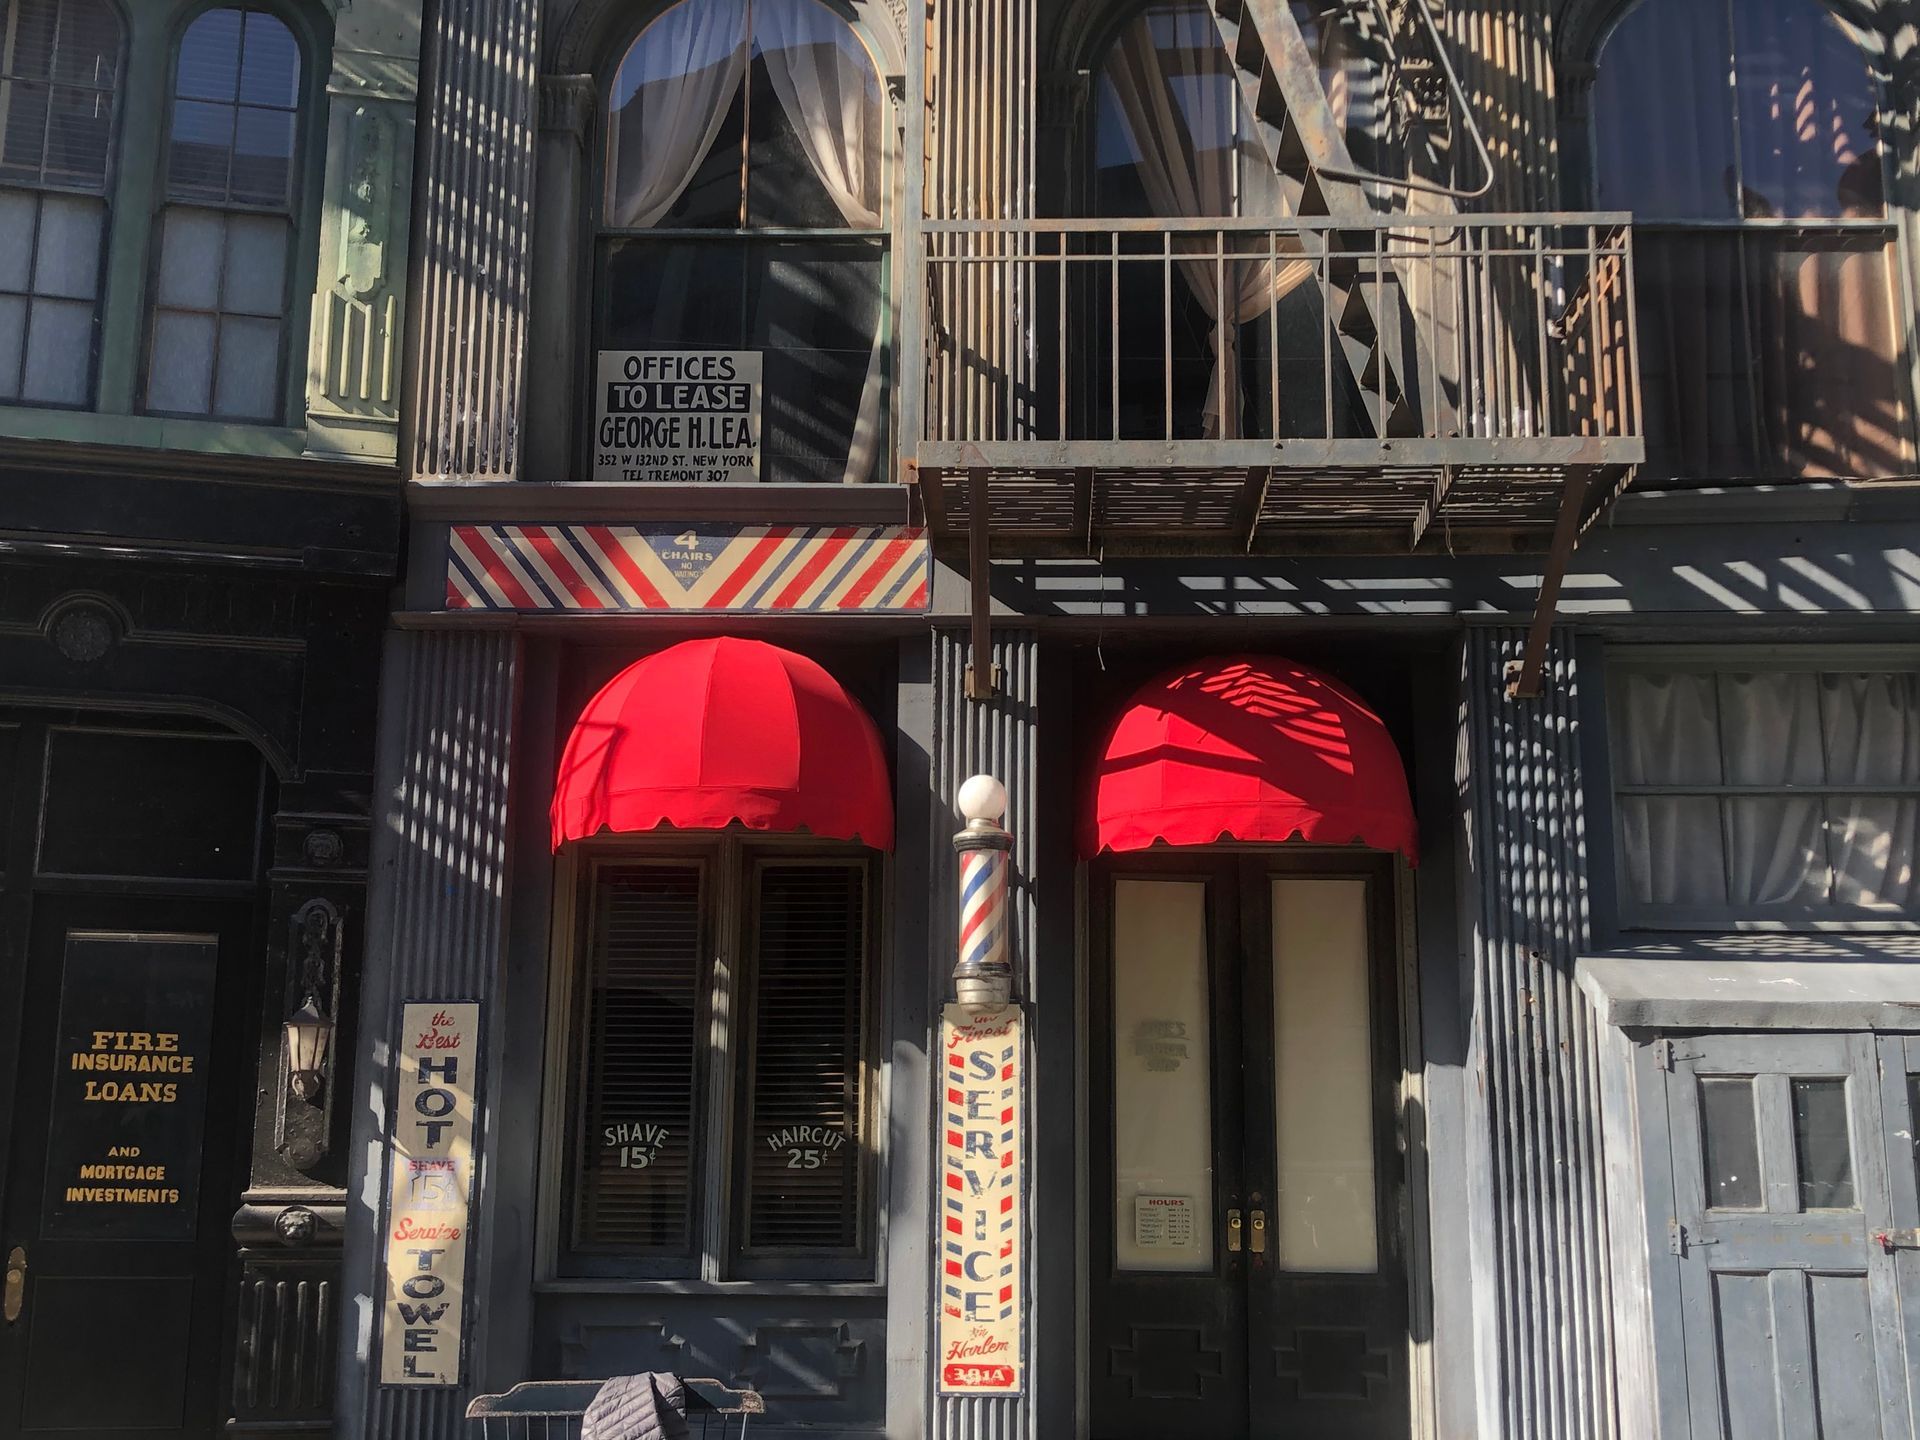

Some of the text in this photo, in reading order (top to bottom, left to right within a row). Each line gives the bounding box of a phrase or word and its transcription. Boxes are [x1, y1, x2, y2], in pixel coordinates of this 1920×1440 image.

[623, 355, 736, 381] OFFICES
[613, 384, 746, 410] TO LEASE
[600, 416, 681, 449] GEORGE
[598, 454, 754, 467] 352 W 132ND ST. NEW YORK
[622, 469, 729, 482] TEL TREMONT 307
[673, 529, 699, 550] 4
[661, 551, 713, 561] CHAIRS
[681, 561, 693, 570] NO
[431, 1010, 456, 1027] the
[91, 1031, 179, 1052] FIRE
[415, 1027, 461, 1050] Best
[71, 1053, 194, 1074] INSURANCE
[84, 1081, 178, 1103] LOANS
[414, 1056, 458, 1149] HOT
[605, 1122, 670, 1149] SHAVE
[766, 1125, 847, 1152] HAIRCUT
[107, 1146, 141, 1157] AND
[80, 1164, 165, 1181] MORTGAGE
[409, 1160, 456, 1171] SHAVE
[66, 1187, 180, 1204] INVESTMENTS
[963, 1050, 1000, 1323] SERVICE
[393, 1217, 462, 1242] Service
[397, 1249, 450, 1379] TOWEL
[946, 1335, 1009, 1361] Harlem
